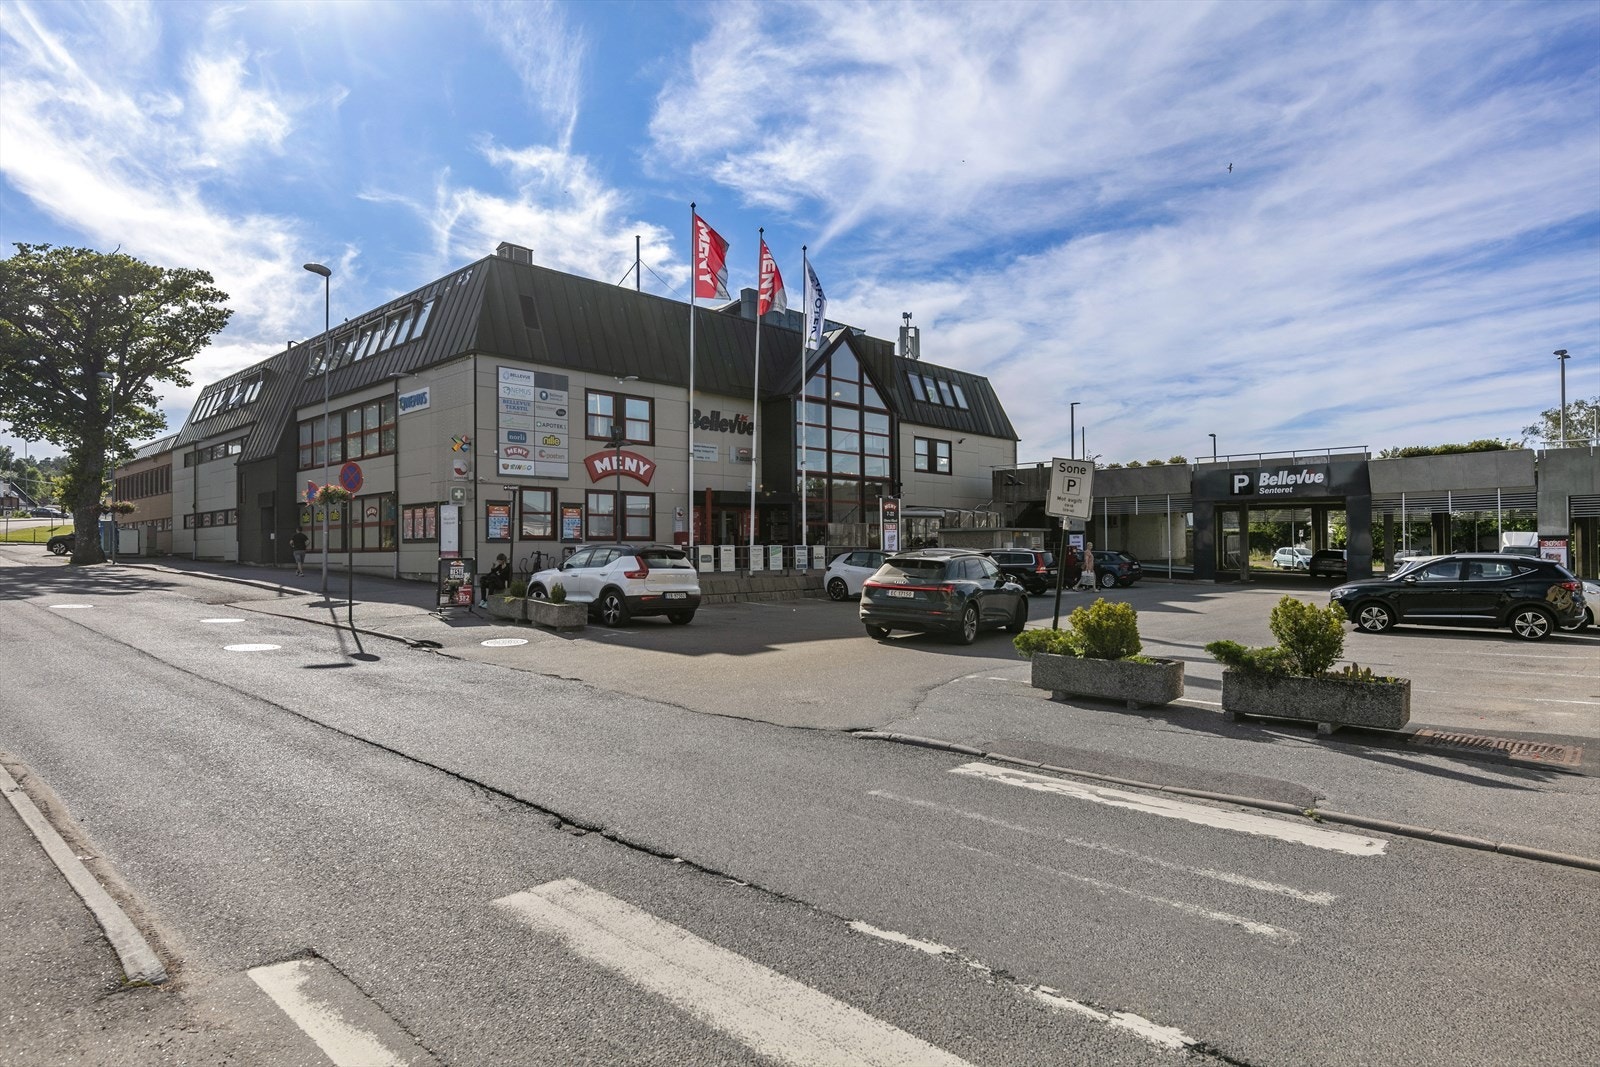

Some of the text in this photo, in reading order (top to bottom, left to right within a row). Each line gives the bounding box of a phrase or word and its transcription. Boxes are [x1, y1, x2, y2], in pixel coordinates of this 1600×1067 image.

[697, 220, 715, 288] MENY
[543, 435, 560, 446] nille
[507, 447, 528, 456] MENY
[593, 456, 650, 475] MENY
[1059, 463, 1086, 474] Sone
[1234, 475, 1249, 494] P
[1259, 469, 1324, 486] Bellevue
[1066, 479, 1076, 492] P
